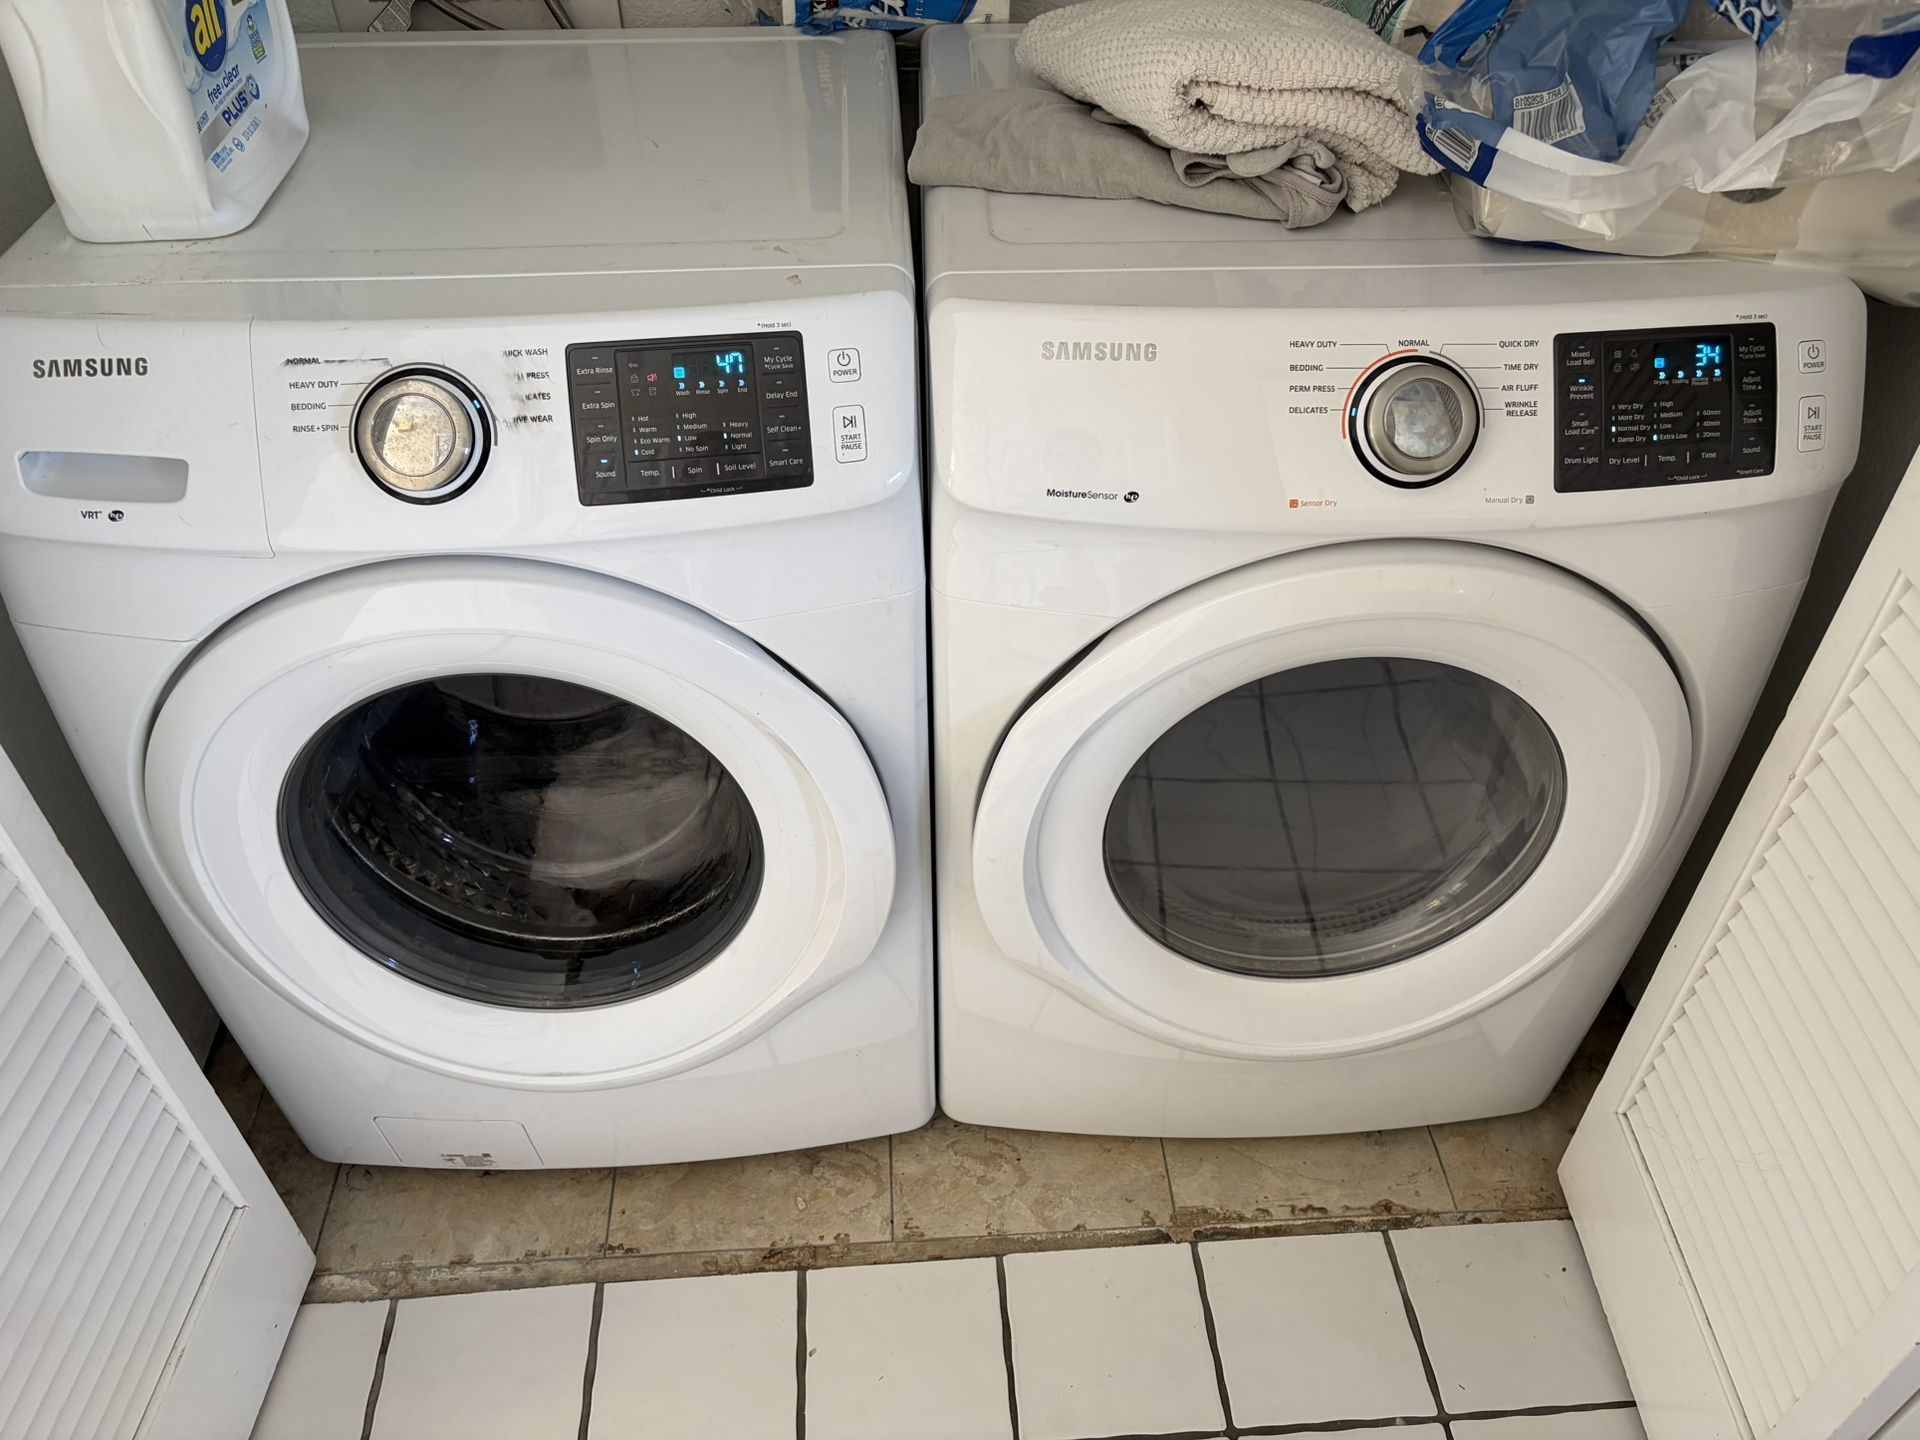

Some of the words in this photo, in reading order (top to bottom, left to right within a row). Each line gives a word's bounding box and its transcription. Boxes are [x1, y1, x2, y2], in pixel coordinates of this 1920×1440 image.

[191, 0, 224, 55] all
[207, 83, 223, 105] free
[223, 64, 240, 89] clear
[1398, 339, 1430, 347] NORMAL
[1499, 340, 1523, 348] QUICK
[525, 348, 548, 356] WASH
[1041, 341, 1157, 362] SAMSUNG
[1570, 350, 1590, 358] Mixed
[1695, 344, 1720, 366] 34
[716, 352, 743, 374] 47
[775, 355, 792, 363] Cycle
[33, 357, 148, 378] SAMSUNG
[1289, 364, 1324, 372] BEDDING
[1504, 363, 1522, 371] TIME
[1523, 363, 1539, 371] DRY
[1803, 361, 1825, 369] POWER
[526, 371, 550, 379] PRESS
[833, 368, 857, 376] POWER
[1743, 376, 1761, 384] Adjust
[289, 381, 315, 389] HEAVY
[1289, 385, 1311, 393] PERM
[1312, 385, 1336, 393] PRESS
[1501, 384, 1514, 392] AIR
[766, 392, 784, 400] Delay
[291, 402, 327, 411] BEDDING
[601, 402, 615, 410] Spin
[530, 415, 553, 423] WEAR
[766, 426, 779, 434] Self
[1804, 424, 1823, 432] START
[586, 436, 601, 444] Spin
[602, 435, 617, 443] Only
[841, 433, 861, 442] START
[1803, 433, 1822, 441] PAUSE
[1742, 446, 1761, 454] Sound
[769, 459, 787, 467] Smart
[788, 457, 804, 465] Care
[1582, 456, 1599, 465] Light
[724, 464, 736, 472] Soil
[738, 462, 756, 470] Level
[1046, 488, 1118, 500] MoistureSensor
[1324, 499, 1338, 507] Dry
[1510, 496, 1524, 505] Dry
